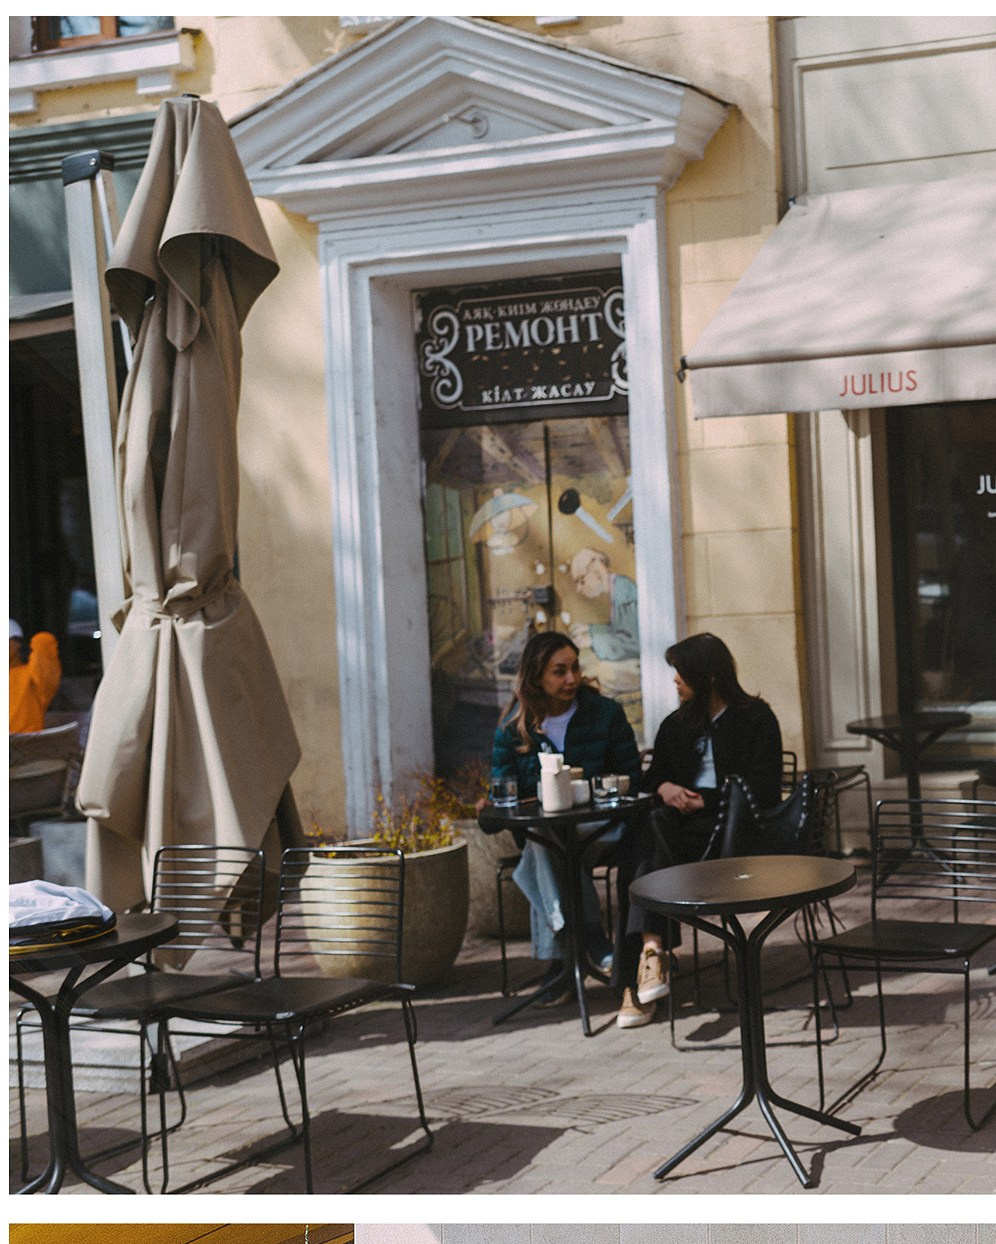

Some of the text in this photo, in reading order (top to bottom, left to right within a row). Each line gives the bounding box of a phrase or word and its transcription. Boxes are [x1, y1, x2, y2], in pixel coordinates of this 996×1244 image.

[466, 312, 603, 353] РЕМОНТ
[531, 381, 596, 400] ЖАСАУ
[839, 370, 918, 397] JULIUS
